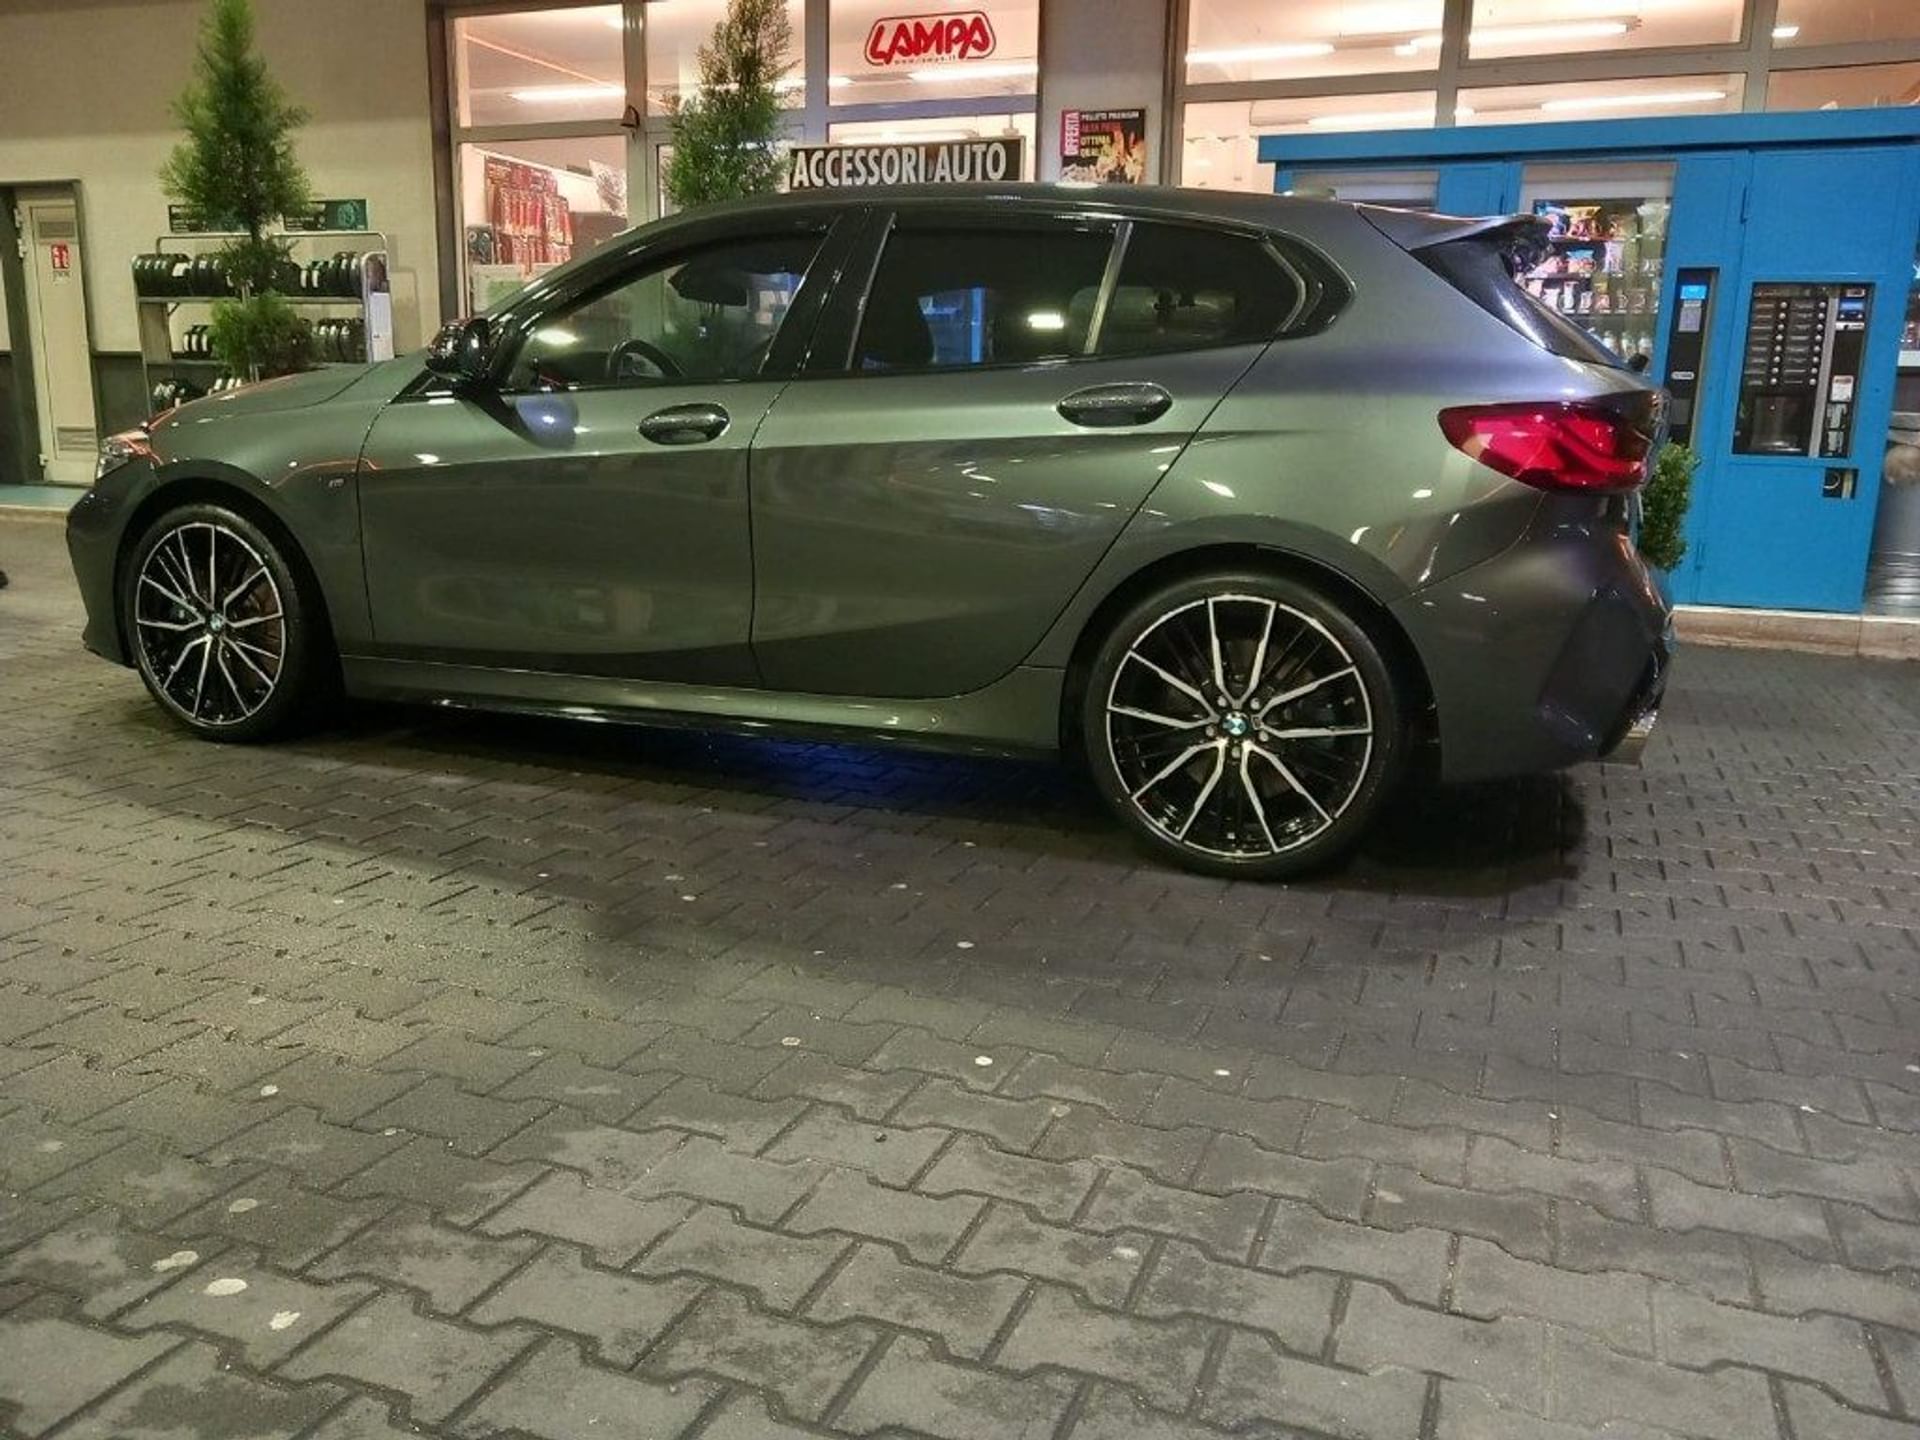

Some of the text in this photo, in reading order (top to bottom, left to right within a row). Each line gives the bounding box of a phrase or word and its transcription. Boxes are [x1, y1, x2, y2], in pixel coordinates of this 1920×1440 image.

[869, 16, 990, 64] LAMPA
[1064, 112, 1080, 156] OFFERTA
[791, 142, 1007, 188] ACCESSORI AUTO
